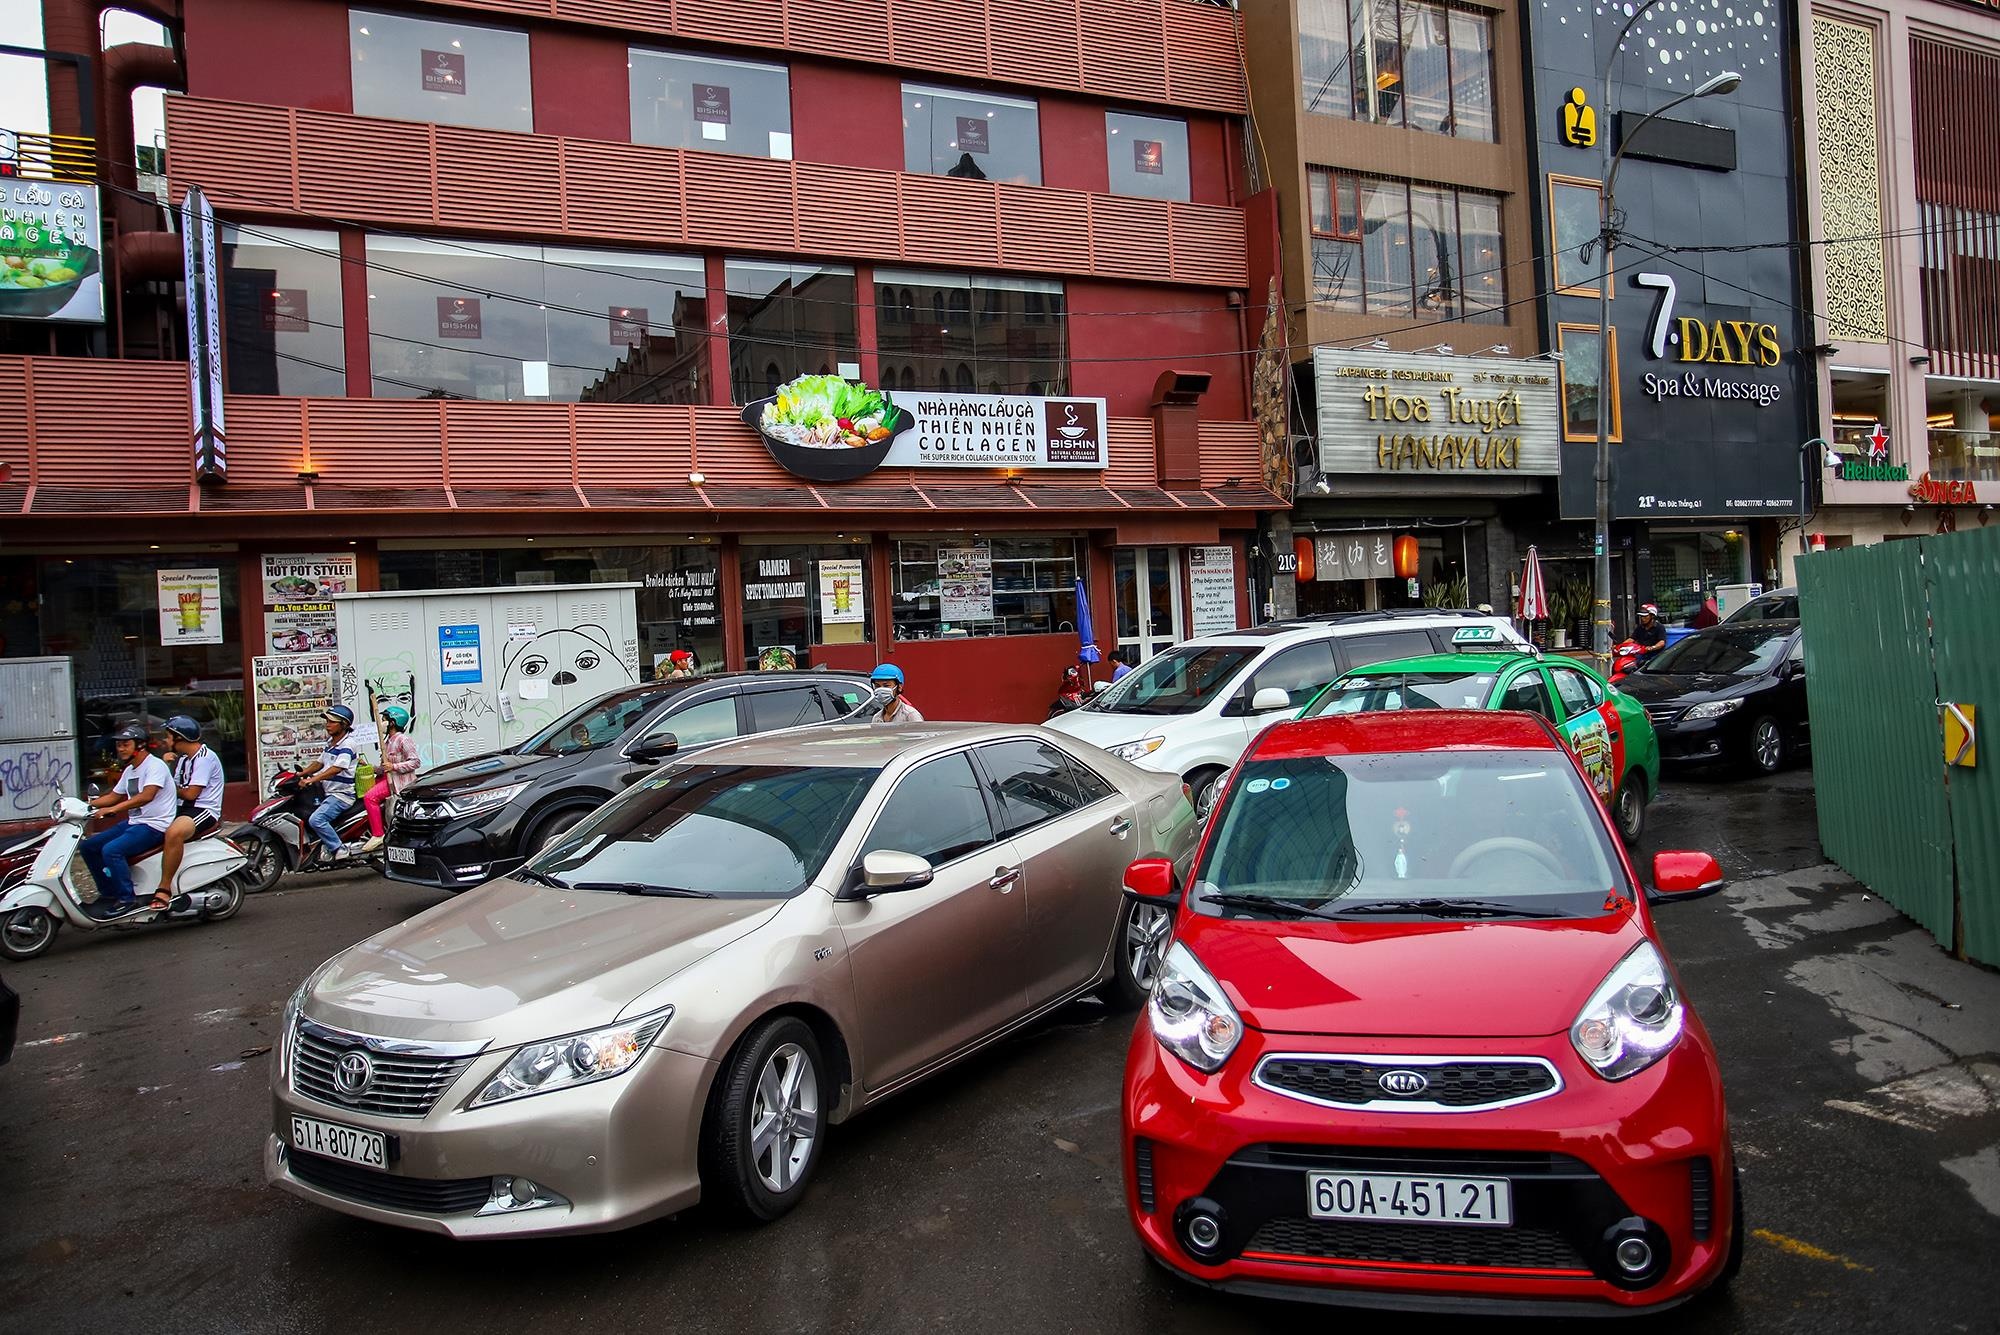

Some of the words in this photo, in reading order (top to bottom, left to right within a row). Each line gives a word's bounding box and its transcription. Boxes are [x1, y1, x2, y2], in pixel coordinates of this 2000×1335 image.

[1678, 317, 1781, 367] DAYS
[1392, 369, 1454, 382] RESTAURANT
[1644, 372, 1679, 402] Spa
[1683, 372, 1701, 397] &
[1704, 377, 1781, 407] Massage
[918, 399, 947, 416] NHÀ
[950, 399, 987, 418] HÀNG
[1016, 401, 1034, 418] GÀ
[1363, 384, 1432, 423] Hoa
[919, 417, 973, 435] THIÊN
[982, 418, 1035, 436] NHIÊN
[919, 437, 1036, 451] COLLAGEN
[1050, 440, 1095, 449] BISHIN
[1378, 433, 1521, 470] HANAYUKI
[966, 454, 994, 462] COLLAGEN
[1843, 461, 1909, 481] Heineken
[266, 565, 288, 577] HOT
[290, 565, 311, 576] POT
[313, 565, 352, 576] STYLE!!
[759, 560, 791, 577] RAMEN
[1278, 554, 1296, 571] 21C
[161, 574, 185, 582] Special
[665, 572, 684, 587] chicken
[745, 584, 762, 600] SPICY
[762, 582, 785, 599] TOMATO
[785, 582, 806, 598] RAMEN
[256, 667, 275, 676] HOT
[277, 666, 294, 675] POT
[296, 664, 330, 674] STYLE!!
[1386, 1075, 1419, 1090] KIA
[294, 1119, 383, 1165] 51A-807.29
[1315, 1178, 1497, 1219] 60A-451.21
